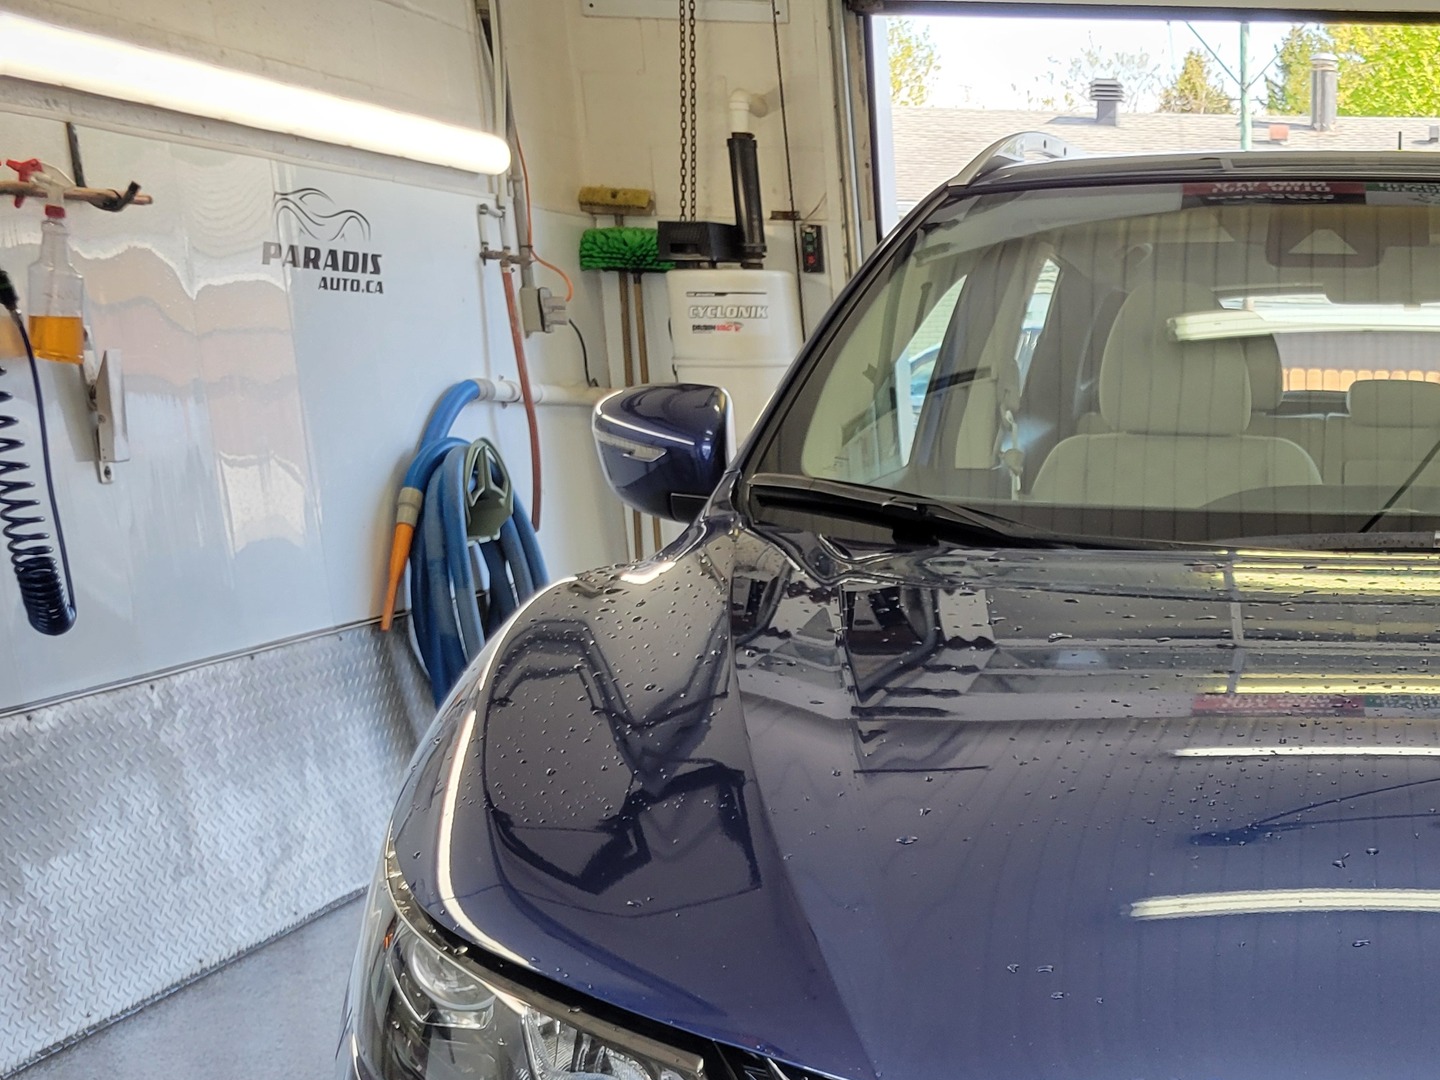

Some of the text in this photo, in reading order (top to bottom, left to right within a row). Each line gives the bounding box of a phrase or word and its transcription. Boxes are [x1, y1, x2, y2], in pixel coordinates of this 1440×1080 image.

[262, 241, 382, 275] PARADIS
[318, 276, 384, 294] AUTO.CA
[689, 305, 768, 319] CYCLONIK
